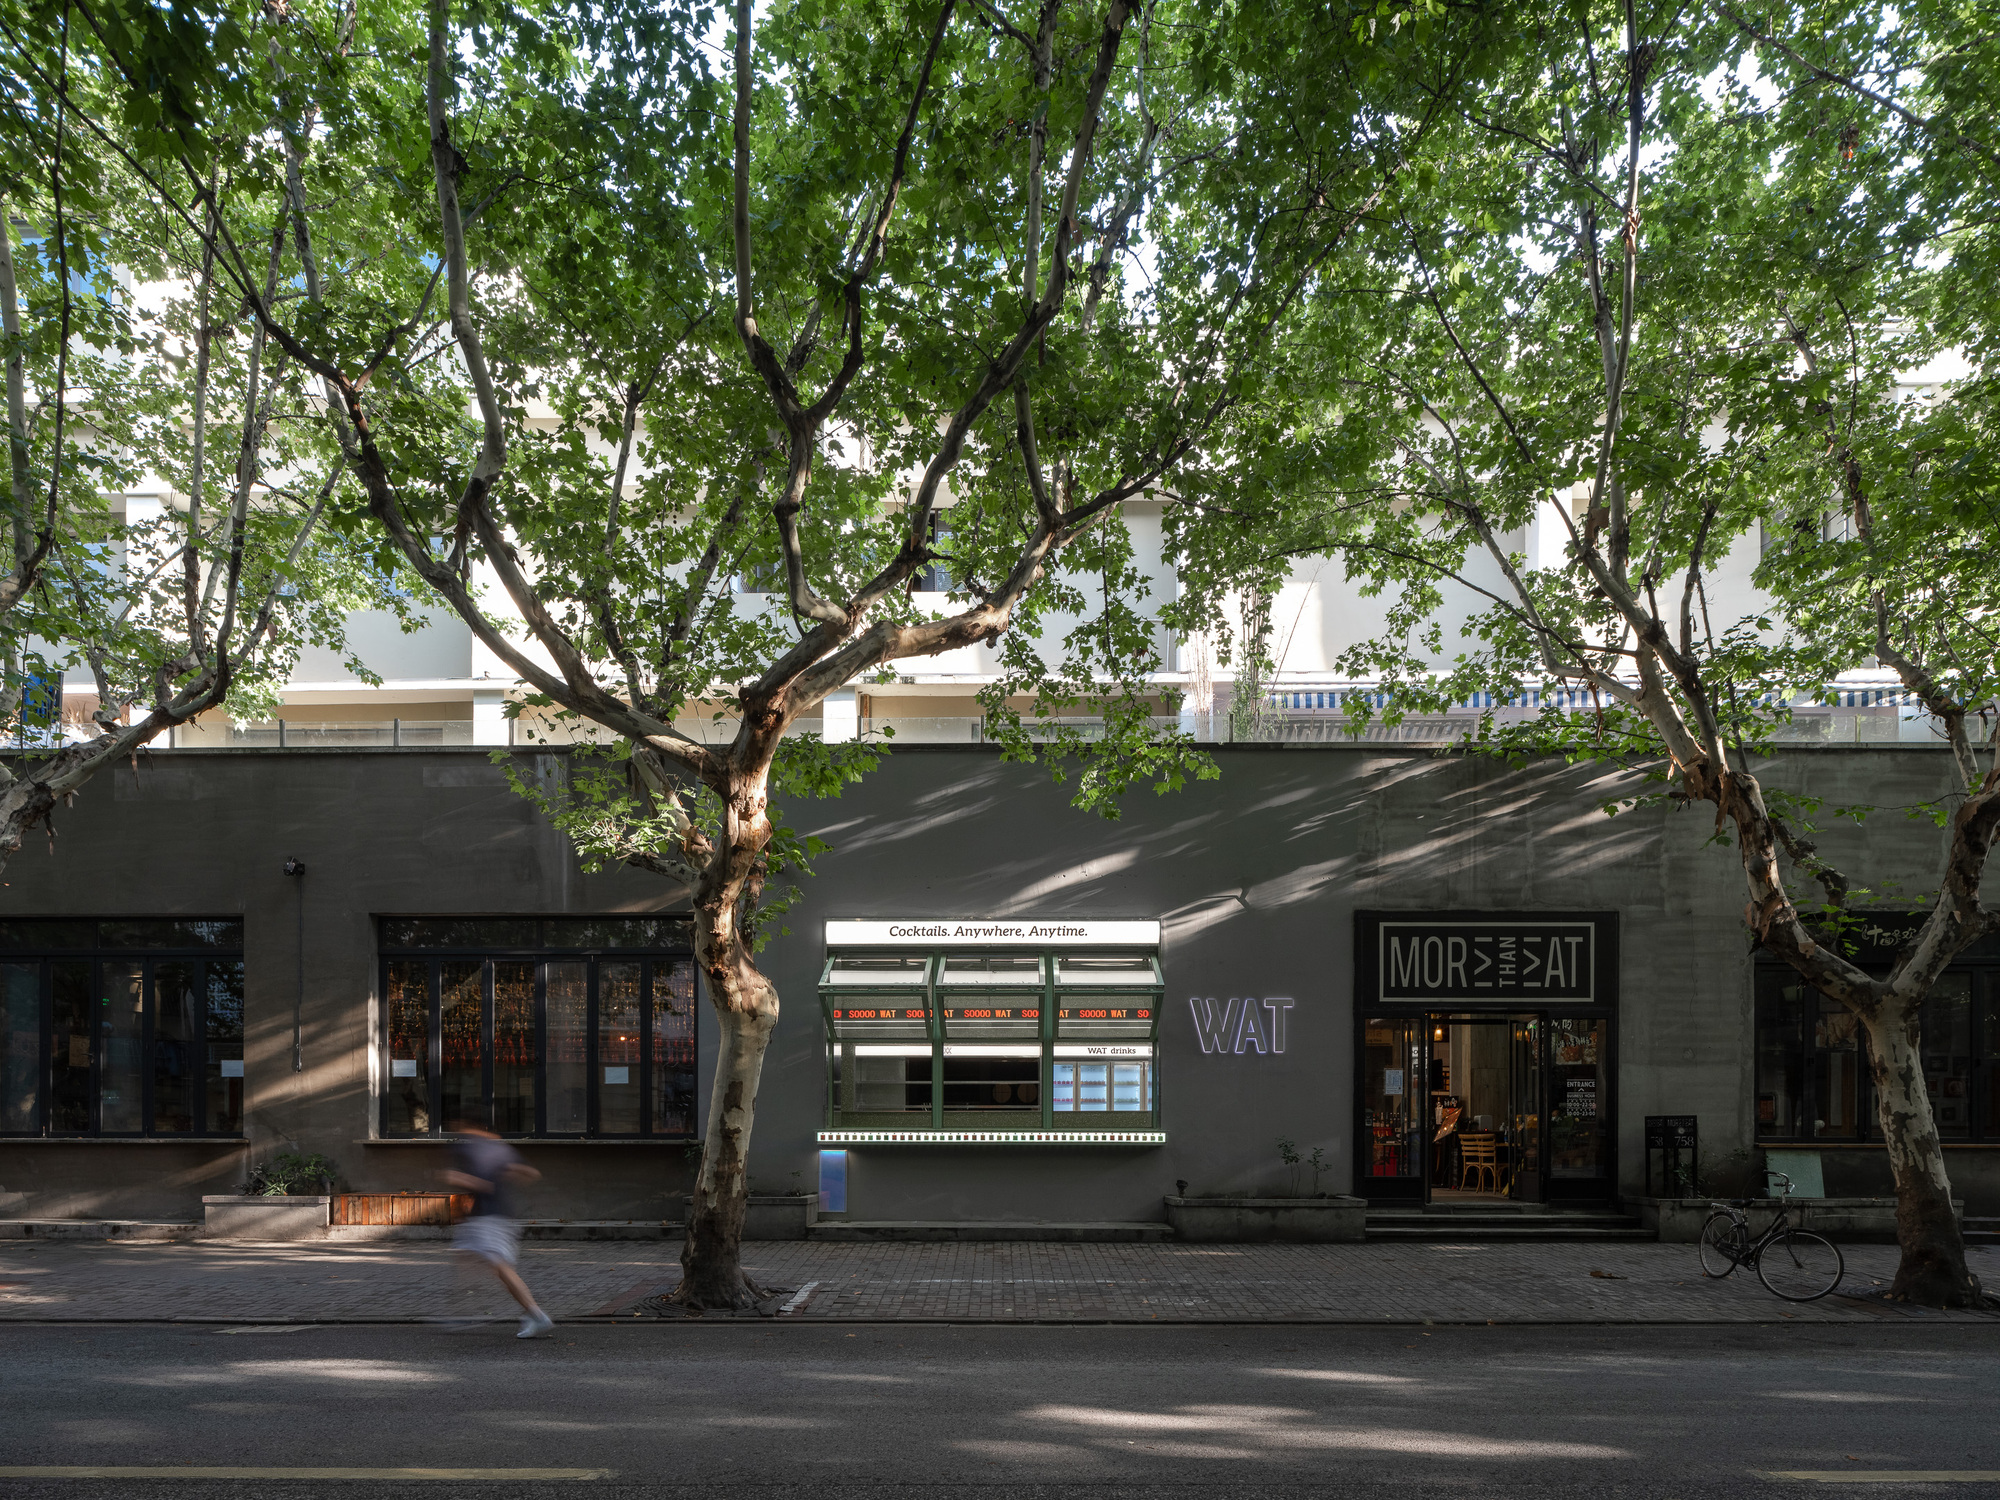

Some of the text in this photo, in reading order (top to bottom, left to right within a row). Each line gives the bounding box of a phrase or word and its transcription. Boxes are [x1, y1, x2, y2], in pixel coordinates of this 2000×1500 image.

[889, 925, 1088, 939] Cocktails. Anywhere, Anytime.
[1498, 936, 1517, 988] THAN
[848, 1009, 876, 1018] SOOOO
[880, 1009, 897, 1018] WAT
[944, 1009, 954, 1018] AT
[964, 1009, 991, 1018] SOOOO
[995, 1009, 1012, 1018] WAT
[1021, 1009, 1039, 1018] SOO
[1059, 1009, 1070, 1018] AT
[1079, 1009, 1107, 1018] SOOOO
[1111, 1009, 1127, 1018] WAT
[1189, 997, 1295, 1054] WAT
[1087, 1047, 1108, 1055] WAT
[1110, 1046, 1137, 1055] drinks
[1674, 1136, 1695, 1147] 758
